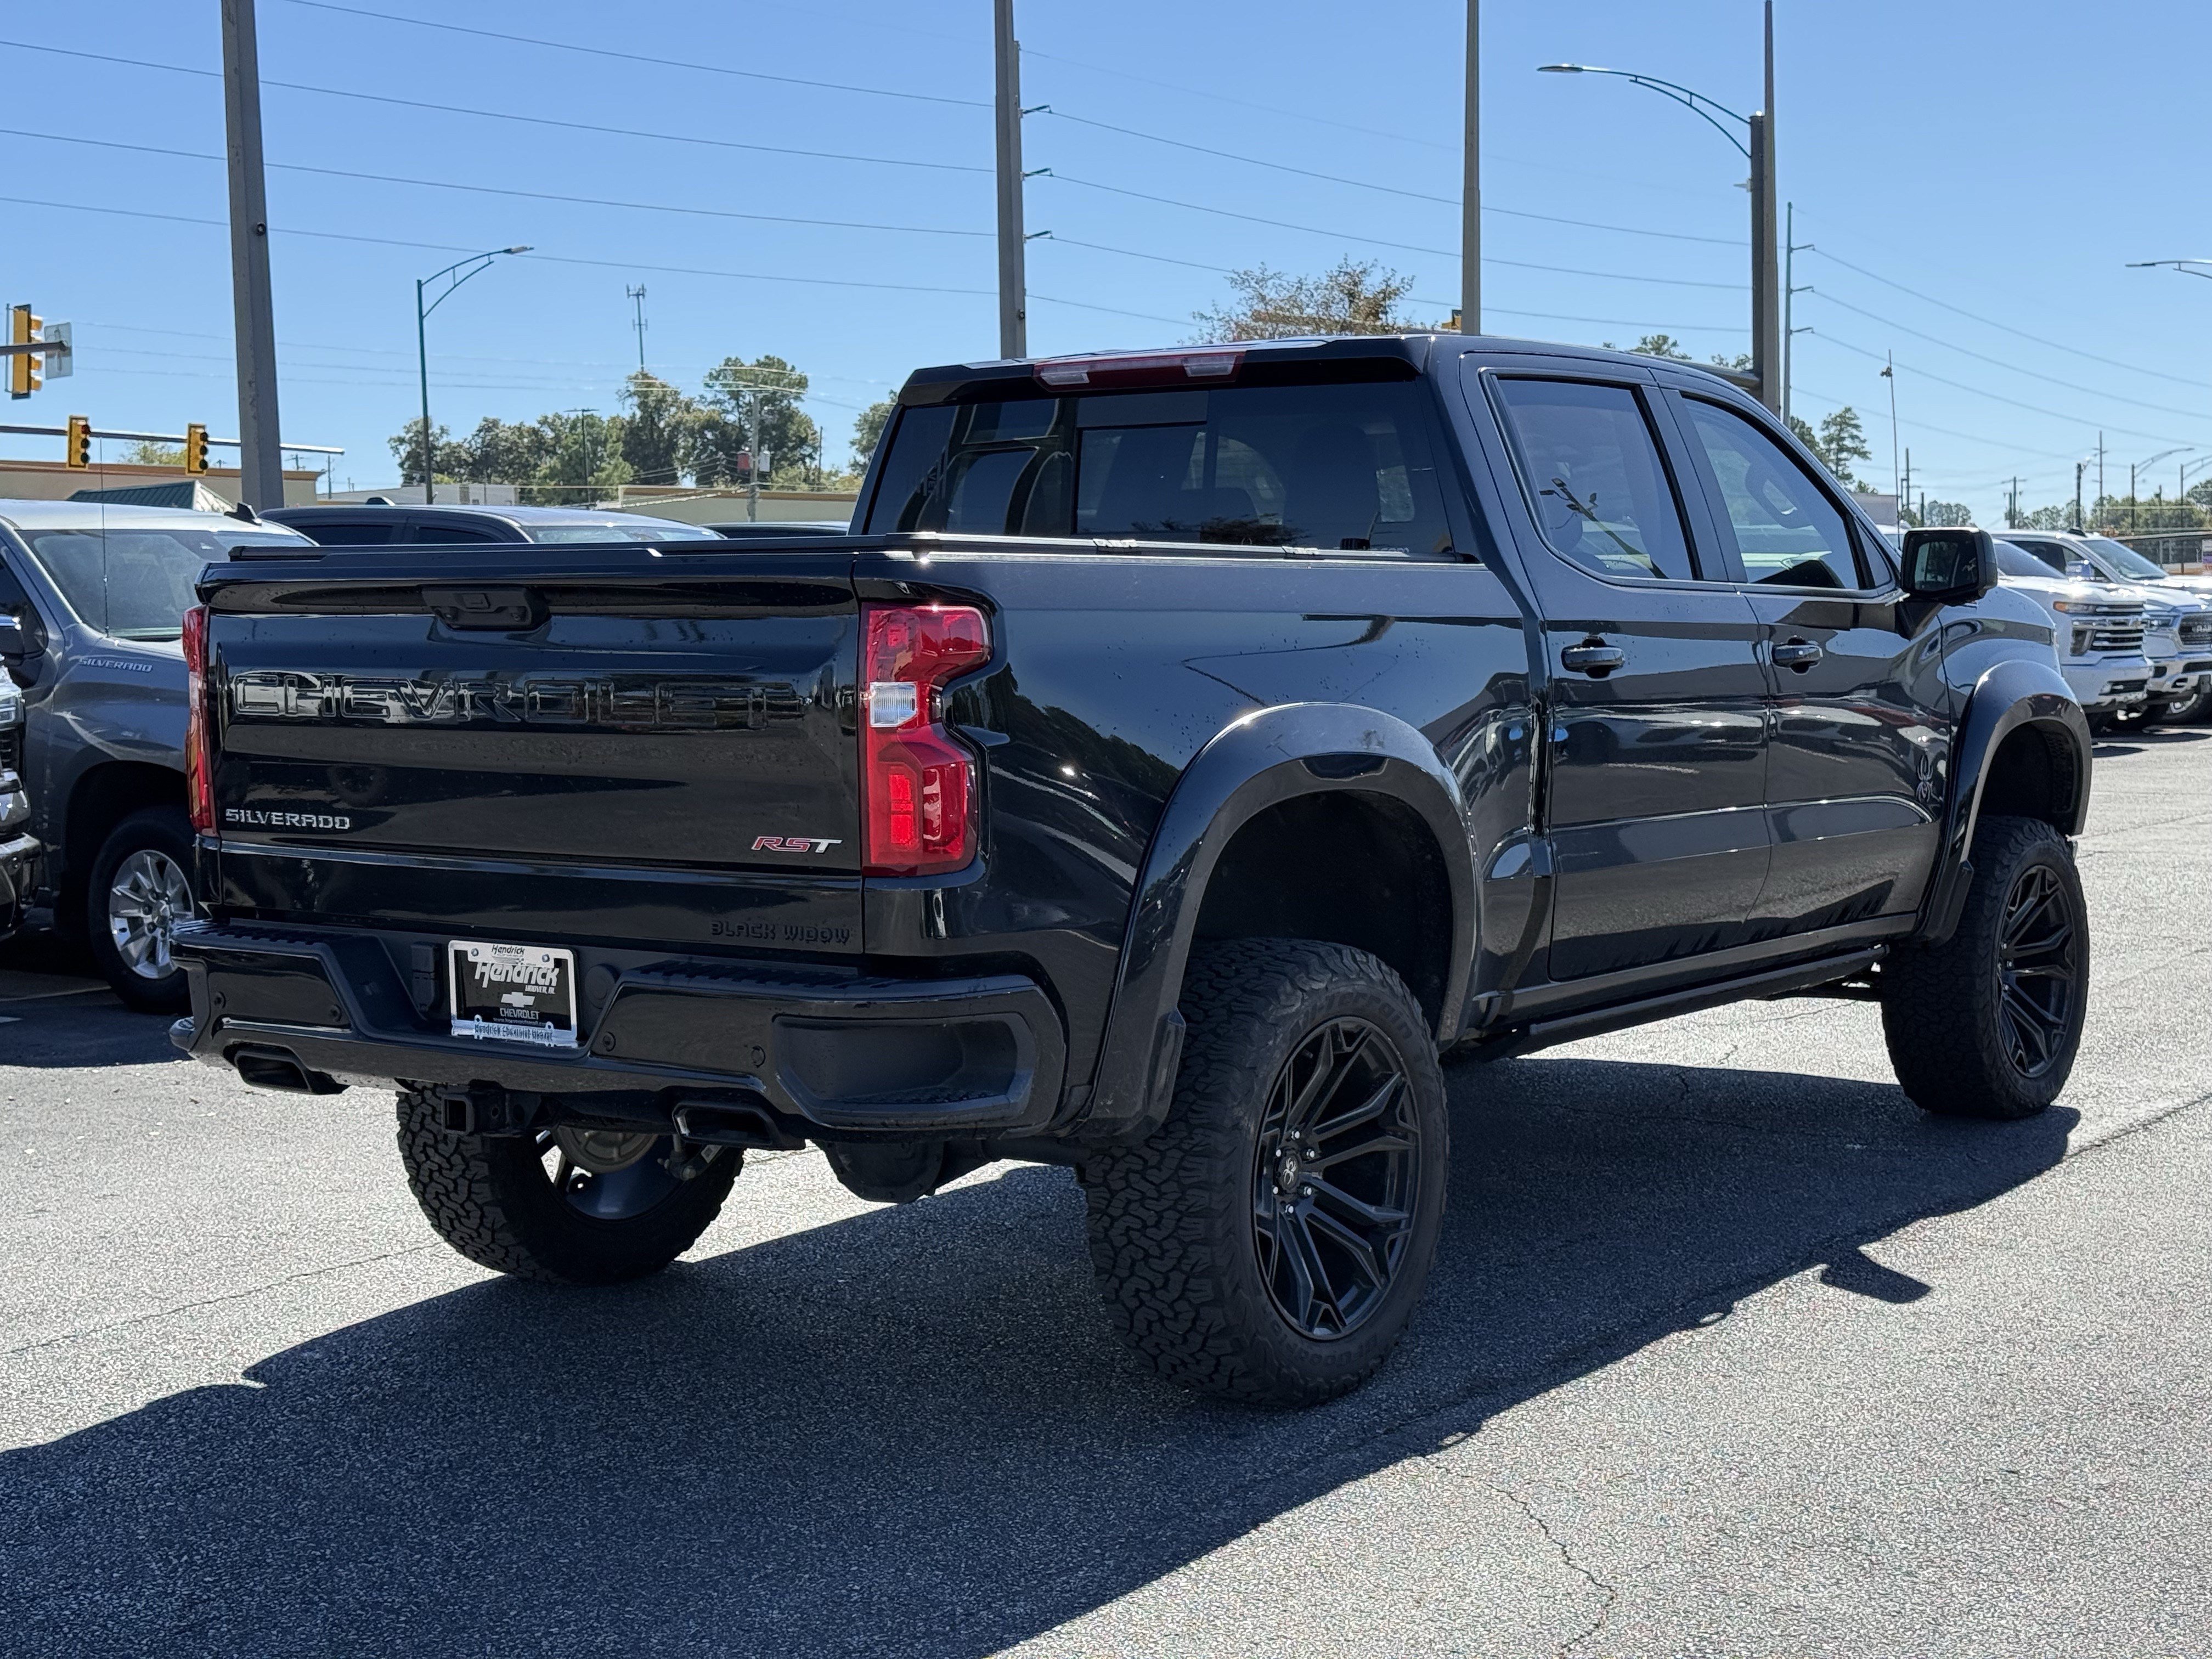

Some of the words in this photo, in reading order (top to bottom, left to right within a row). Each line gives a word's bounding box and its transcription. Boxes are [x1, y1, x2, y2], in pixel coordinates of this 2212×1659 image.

[79, 658, 153, 673] SILVERADO
[232, 674, 800, 727] CHEVROLET
[225, 808, 351, 830] SILVERADO
[751, 836, 843, 854] RST
[712, 921, 776, 940] BLACK
[785, 923, 850, 945] WIDOW
[492, 944, 525, 955] Hendrick
[475, 962, 560, 988] Hendrick
[500, 1007, 540, 1020] CHEVROLET
